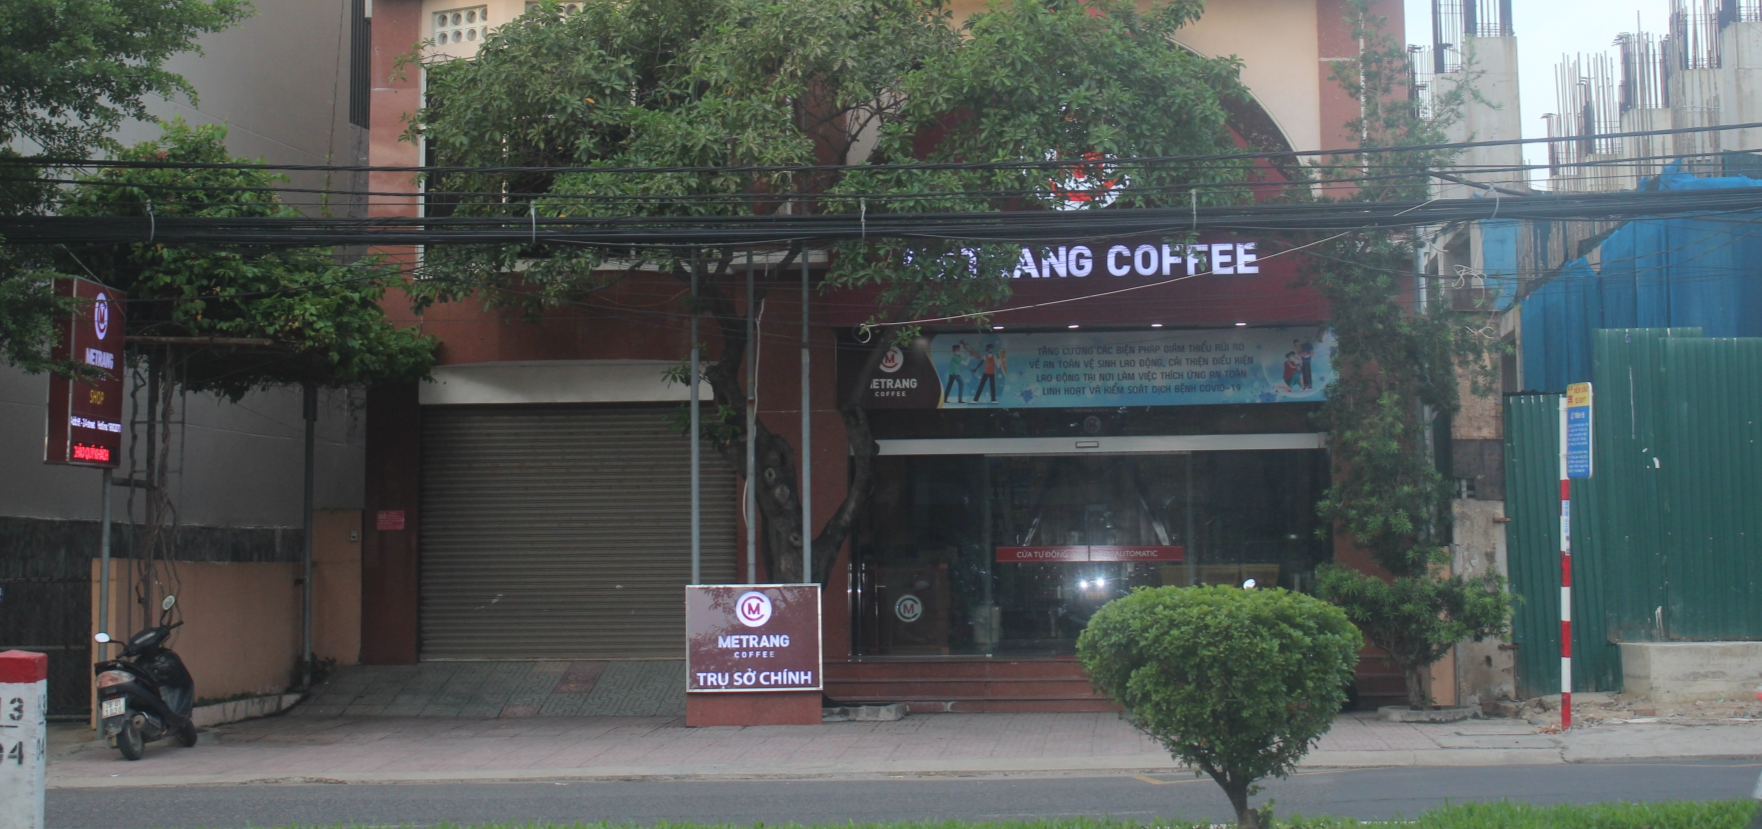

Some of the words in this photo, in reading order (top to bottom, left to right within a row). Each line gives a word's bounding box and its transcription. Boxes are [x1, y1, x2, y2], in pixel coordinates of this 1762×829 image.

[1038, 346, 1059, 355] TĂNG
[1062, 346, 1093, 355] CƯỜNG
[1097, 344, 1113, 355] CÁC
[1116, 344, 1135, 355] BIỆN
[1138, 344, 1160, 354] PHÁP
[1164, 343, 1185, 353] GIẢM
[1189, 341, 1211, 352] THIỂU
[1215, 342, 1229, 352] RỦI
[1233, 343, 1244, 351] RO
[85, 347, 114, 370] METRANG
[1043, 360, 1055, 368] AN
[1058, 359, 1080, 368] TOÀN
[1084, 359, 1094, 369] VỆ
[1097, 359, 1116, 368] SINH
[1120, 359, 1135, 367] LAO
[1168, 357, 1181, 366] CẢI
[1185, 357, 1208, 368] THIỆN
[1234, 355, 1254, 366] KIỆN
[1036, 374, 1052, 382] LAO
[1056, 372, 1080, 383] ĐỘNG
[1083, 373, 1096, 383] TẠI
[1099, 373, 1114, 381] NƠI
[1117, 371, 1135, 381] LÀM
[1138, 370, 1157, 382] VIỆC
[1160, 369, 1184, 380] THÍCH
[1187, 369, 1206, 379] ỨNG
[1210, 370, 1221, 379] AN
[1224, 369, 1247, 378] TOÀN
[870, 378, 918, 389] ETRANG
[1042, 387, 1061, 395] LINH
[1064, 386, 1085, 397] HOẠT
[1089, 385, 1101, 395] VÀ
[1104, 383, 1124, 394] KIỂM
[1127, 384, 1149, 394] SOÁT
[1152, 385, 1171, 395] DỊCH
[1174, 383, 1196, 394] BỆNH
[1200, 383, 1241, 392] COVID-19
[90, 389, 104, 405] SHOP
[1016, 550, 1032, 558] CỬA
[1033, 550, 1044, 559] TỰ
[717, 634, 790, 648] METRANG
[696, 672, 729, 689] TRỤ
[733, 668, 757, 686] SỞ
[759, 668, 812, 685] CHÍNH
